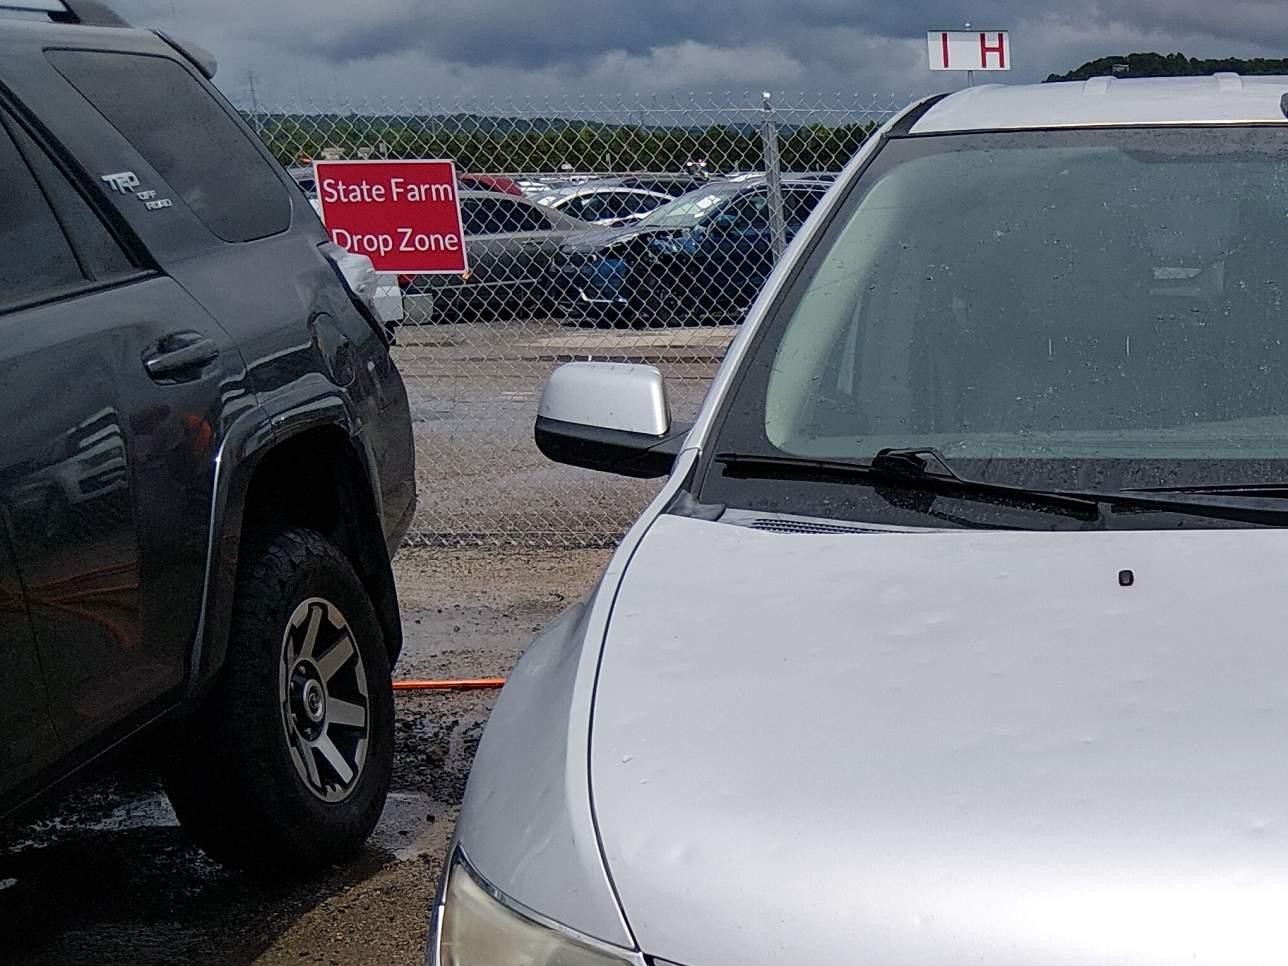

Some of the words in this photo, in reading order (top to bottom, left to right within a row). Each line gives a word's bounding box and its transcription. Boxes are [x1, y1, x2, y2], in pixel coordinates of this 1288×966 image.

[979, 32, 1005, 69] H
[101, 171, 140, 194] TRD
[323, 178, 386, 203] State
[390, 177, 453, 202] Farm
[331, 228, 393, 257] Drop
[396, 227, 459, 251] Zone
